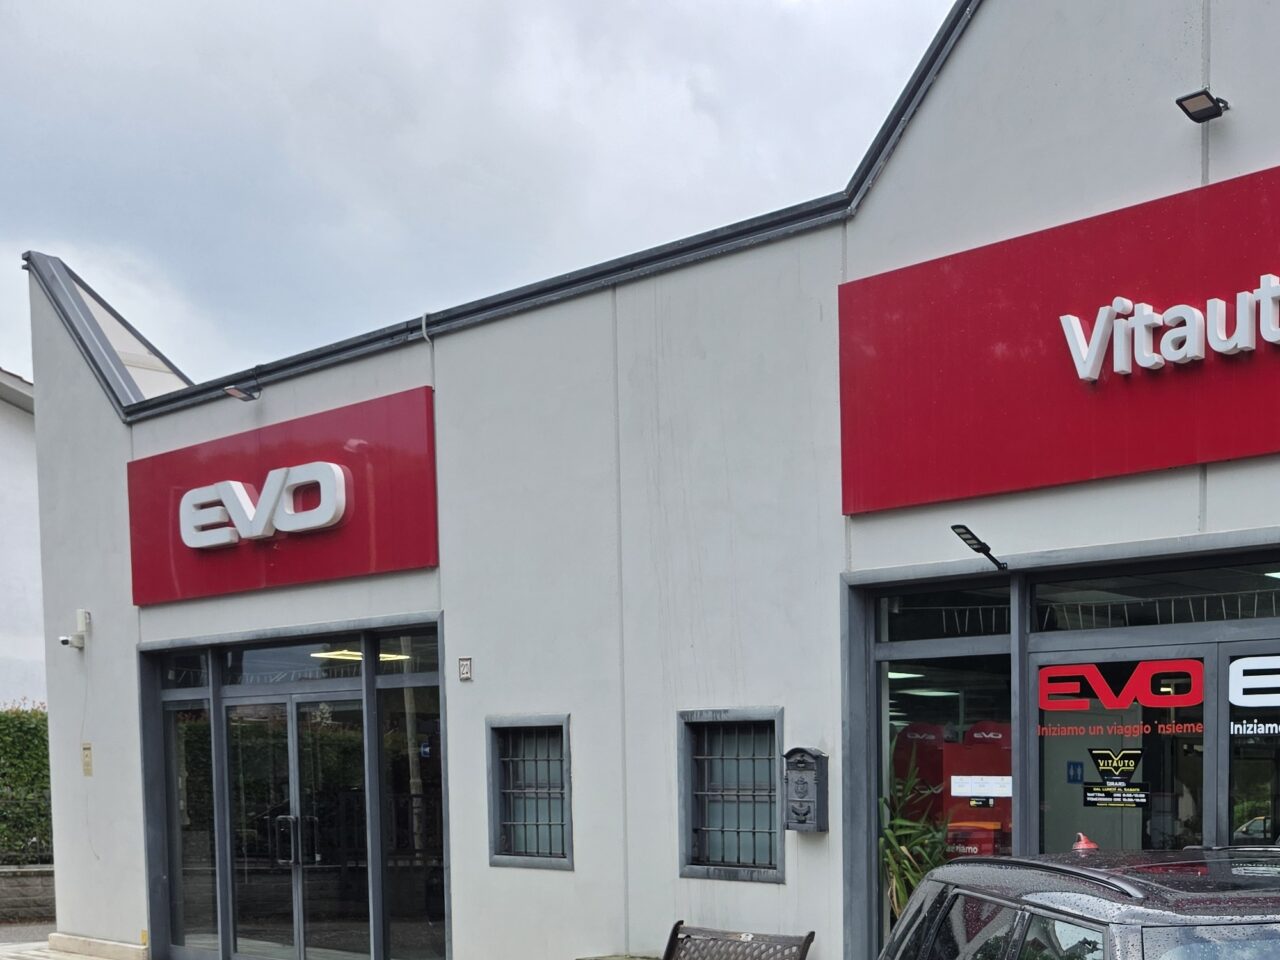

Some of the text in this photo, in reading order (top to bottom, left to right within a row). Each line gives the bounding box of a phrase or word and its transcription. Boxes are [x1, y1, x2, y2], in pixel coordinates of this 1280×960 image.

[179, 461, 346, 549] EVO
[1039, 659, 1204, 711] EVO
[1037, 720, 1204, 737] Iniziamo un viaggio nsieme
[1098, 759, 1136, 767] VITAUTO
